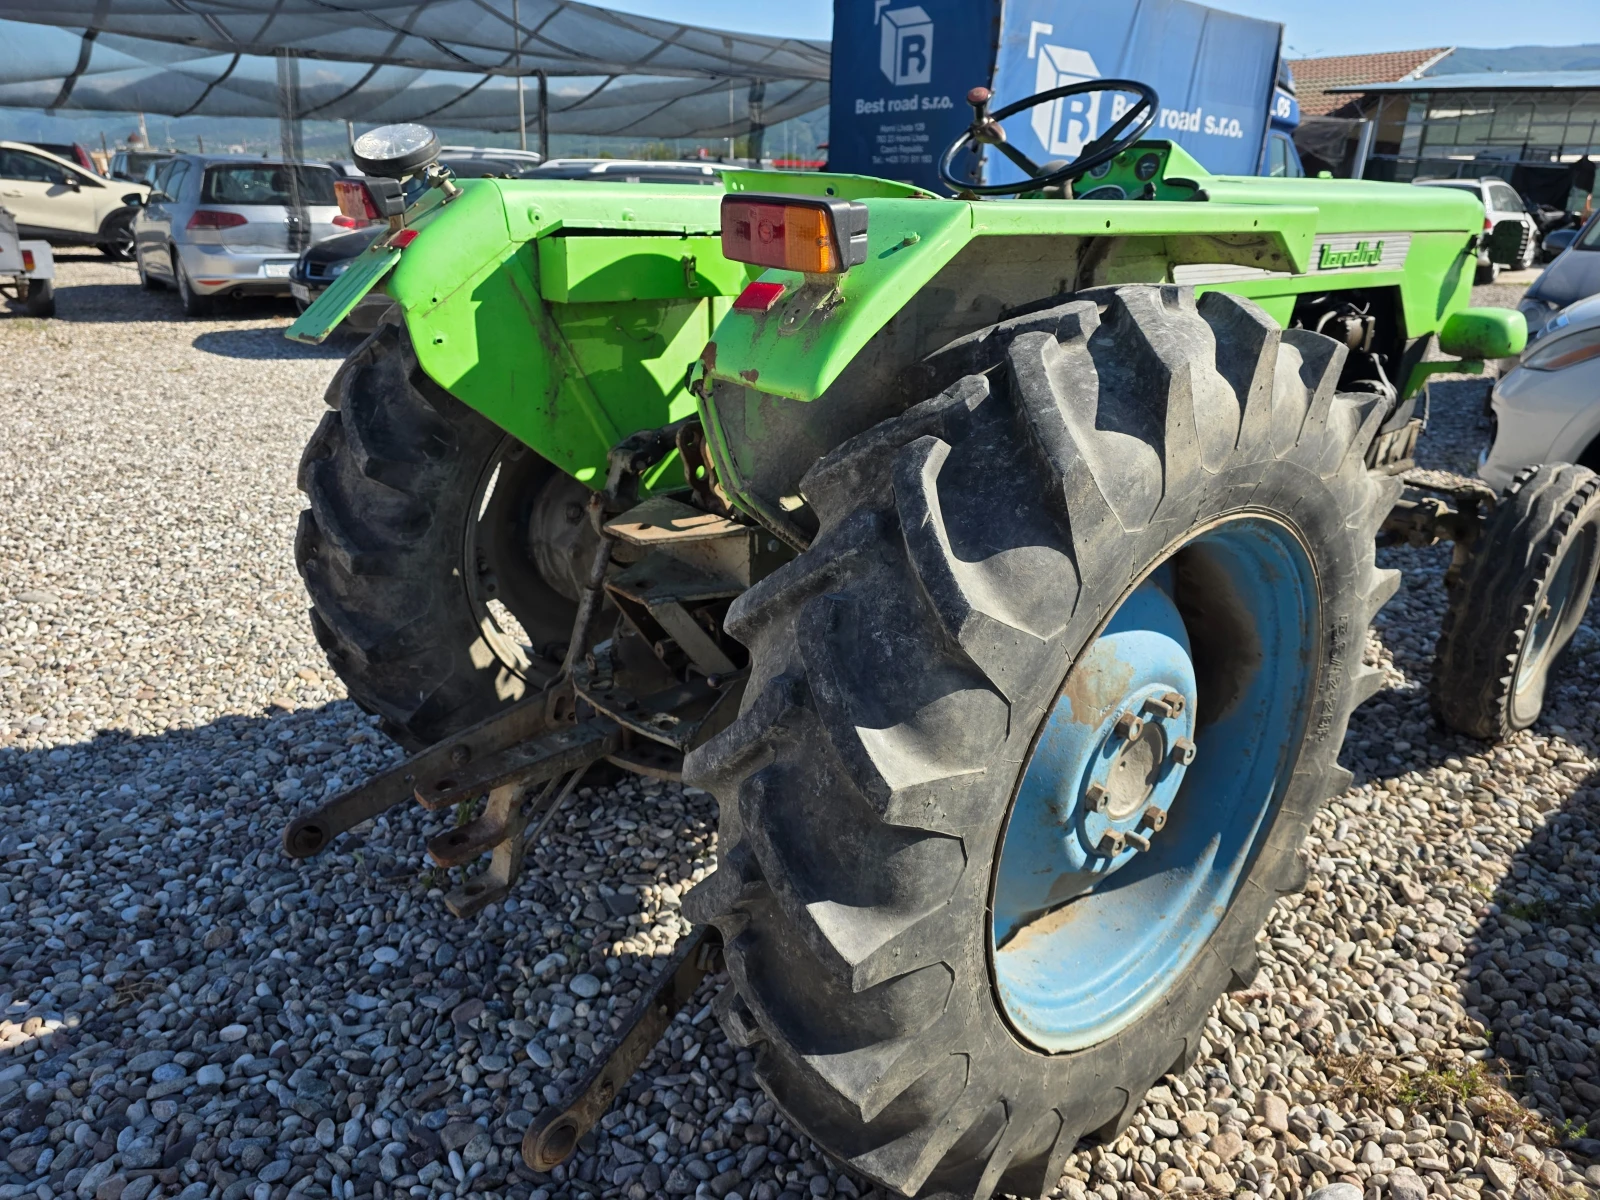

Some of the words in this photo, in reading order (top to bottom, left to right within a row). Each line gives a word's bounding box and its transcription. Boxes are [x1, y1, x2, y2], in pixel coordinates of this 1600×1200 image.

[855, 98, 886, 114] Best
[887, 94, 919, 111] road
[921, 96, 954, 110] s.r.o.
[1159, 107, 1202, 132] road
[1204, 114, 1243, 138] s.r.o.
